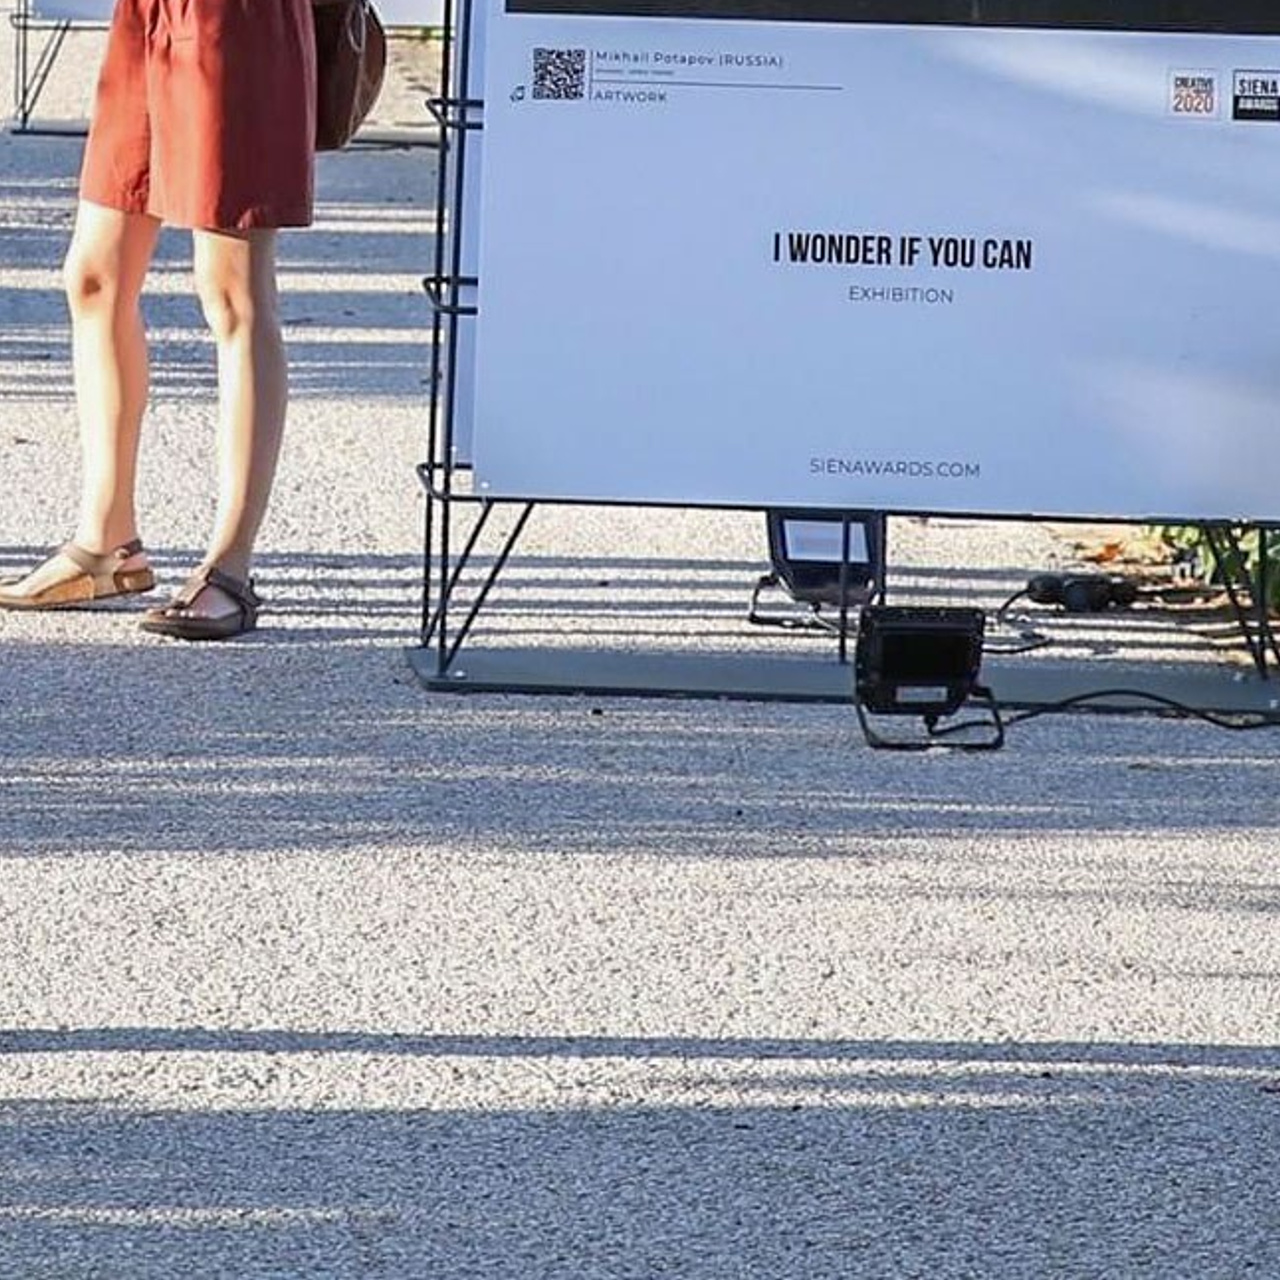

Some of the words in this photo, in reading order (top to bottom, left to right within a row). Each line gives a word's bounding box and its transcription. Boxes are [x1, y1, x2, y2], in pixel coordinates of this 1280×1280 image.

[596, 51, 649, 63] Mikhail
[654, 53, 714, 66] Potapov
[719, 54, 783, 67] (RUSSIA)
[1238, 79, 1279, 94] SIENA
[594, 91, 667, 102] ARTWORK
[1173, 94, 1214, 113] 2020
[773, 232, 780, 262] I
[788, 233, 892, 265] WONDER
[899, 236, 921, 266] IF
[927, 237, 975, 267] YOU
[982, 239, 1032, 269] CAN
[849, 286, 953, 303] EXHIBITION
